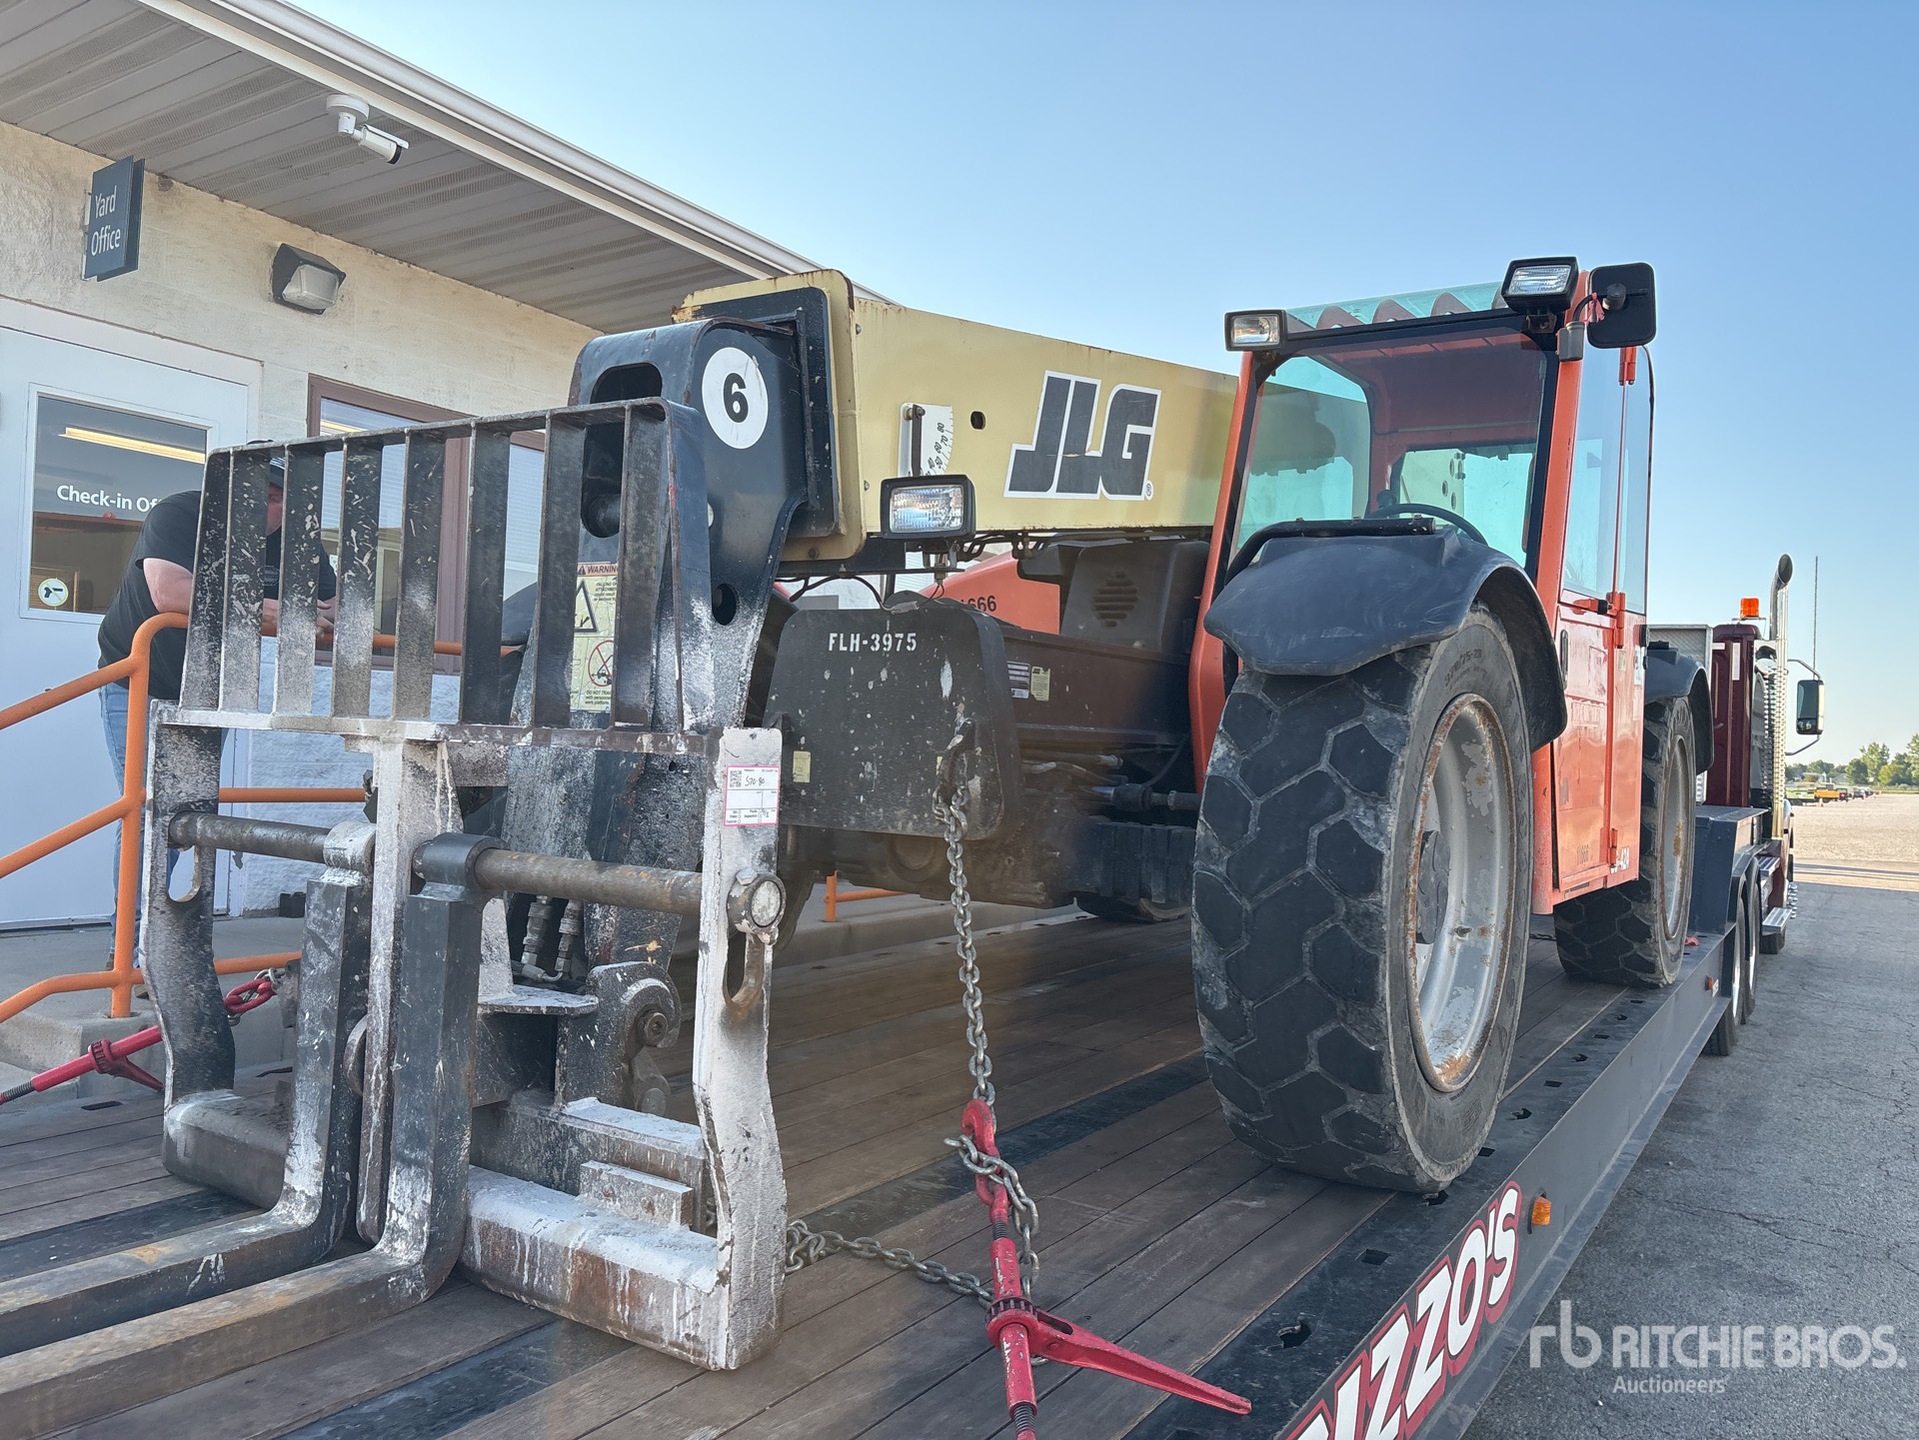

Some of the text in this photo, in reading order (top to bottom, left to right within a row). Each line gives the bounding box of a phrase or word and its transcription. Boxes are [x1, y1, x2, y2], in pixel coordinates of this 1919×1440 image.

[95, 185, 117, 219] Yard
[91, 225, 121, 256] Office
[723, 372, 749, 423] 6
[1004, 370, 1162, 500] JLG
[57, 485, 163, 513] Check-in Of
[588, 565, 618, 574] WARNIN
[828, 632, 917, 652] FLH-3975
